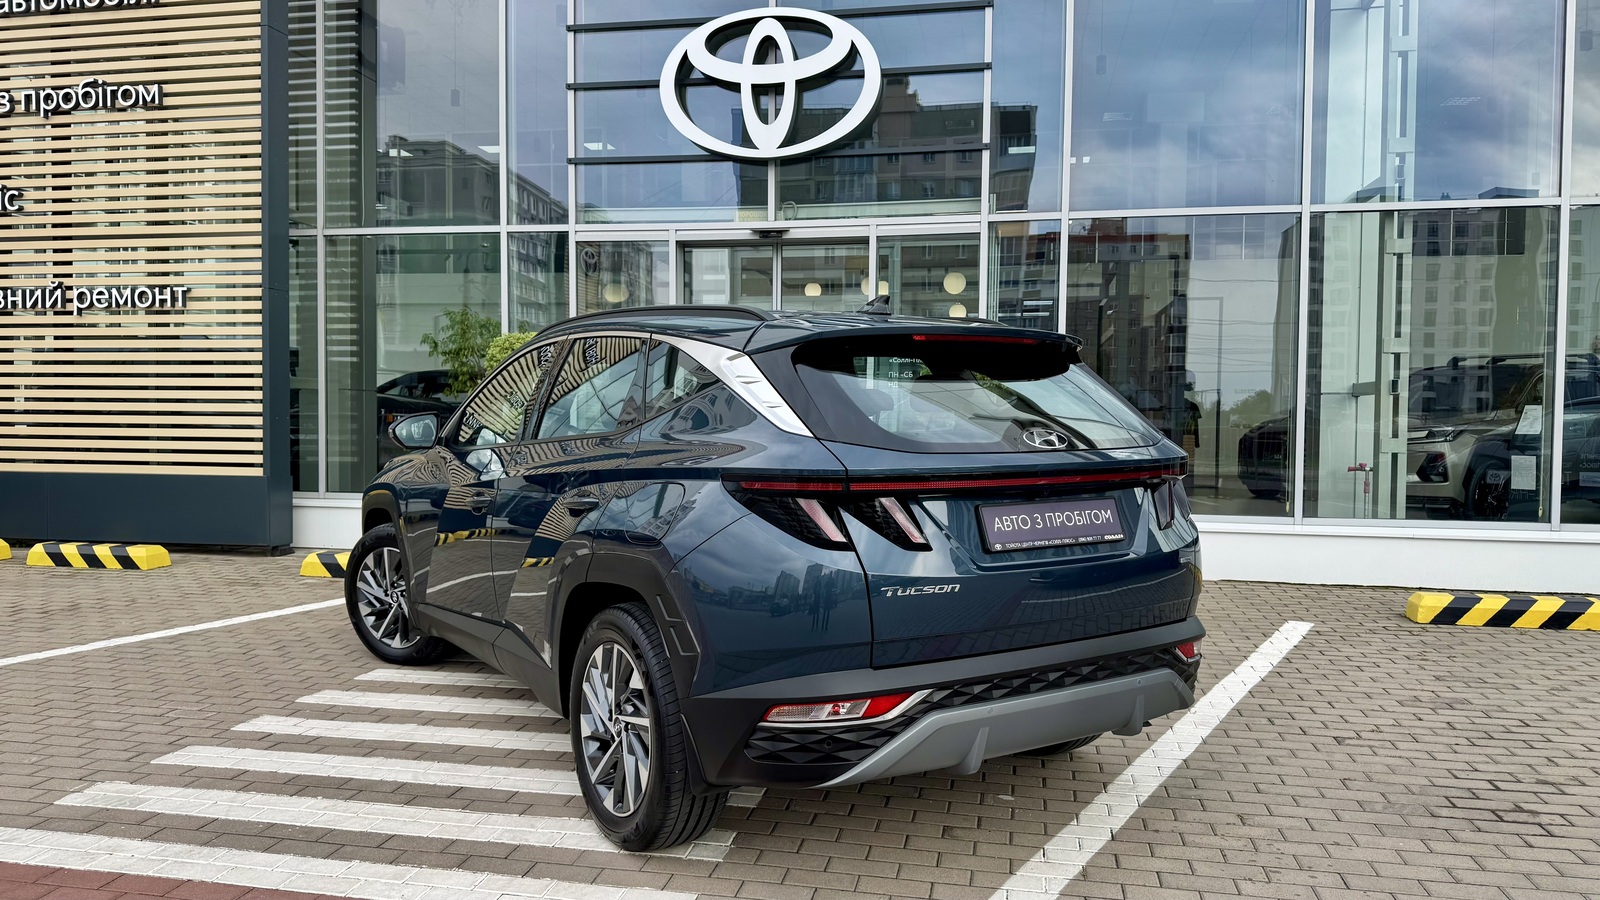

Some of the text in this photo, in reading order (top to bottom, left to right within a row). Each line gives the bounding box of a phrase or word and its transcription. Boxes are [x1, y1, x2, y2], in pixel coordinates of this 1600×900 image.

[21, 78, 160, 118] пробігом
[73, 284, 188, 316] ремонт
[994, 513, 1031, 532] АВТО
[1045, 509, 1114, 528] ПРОБІГОМ
